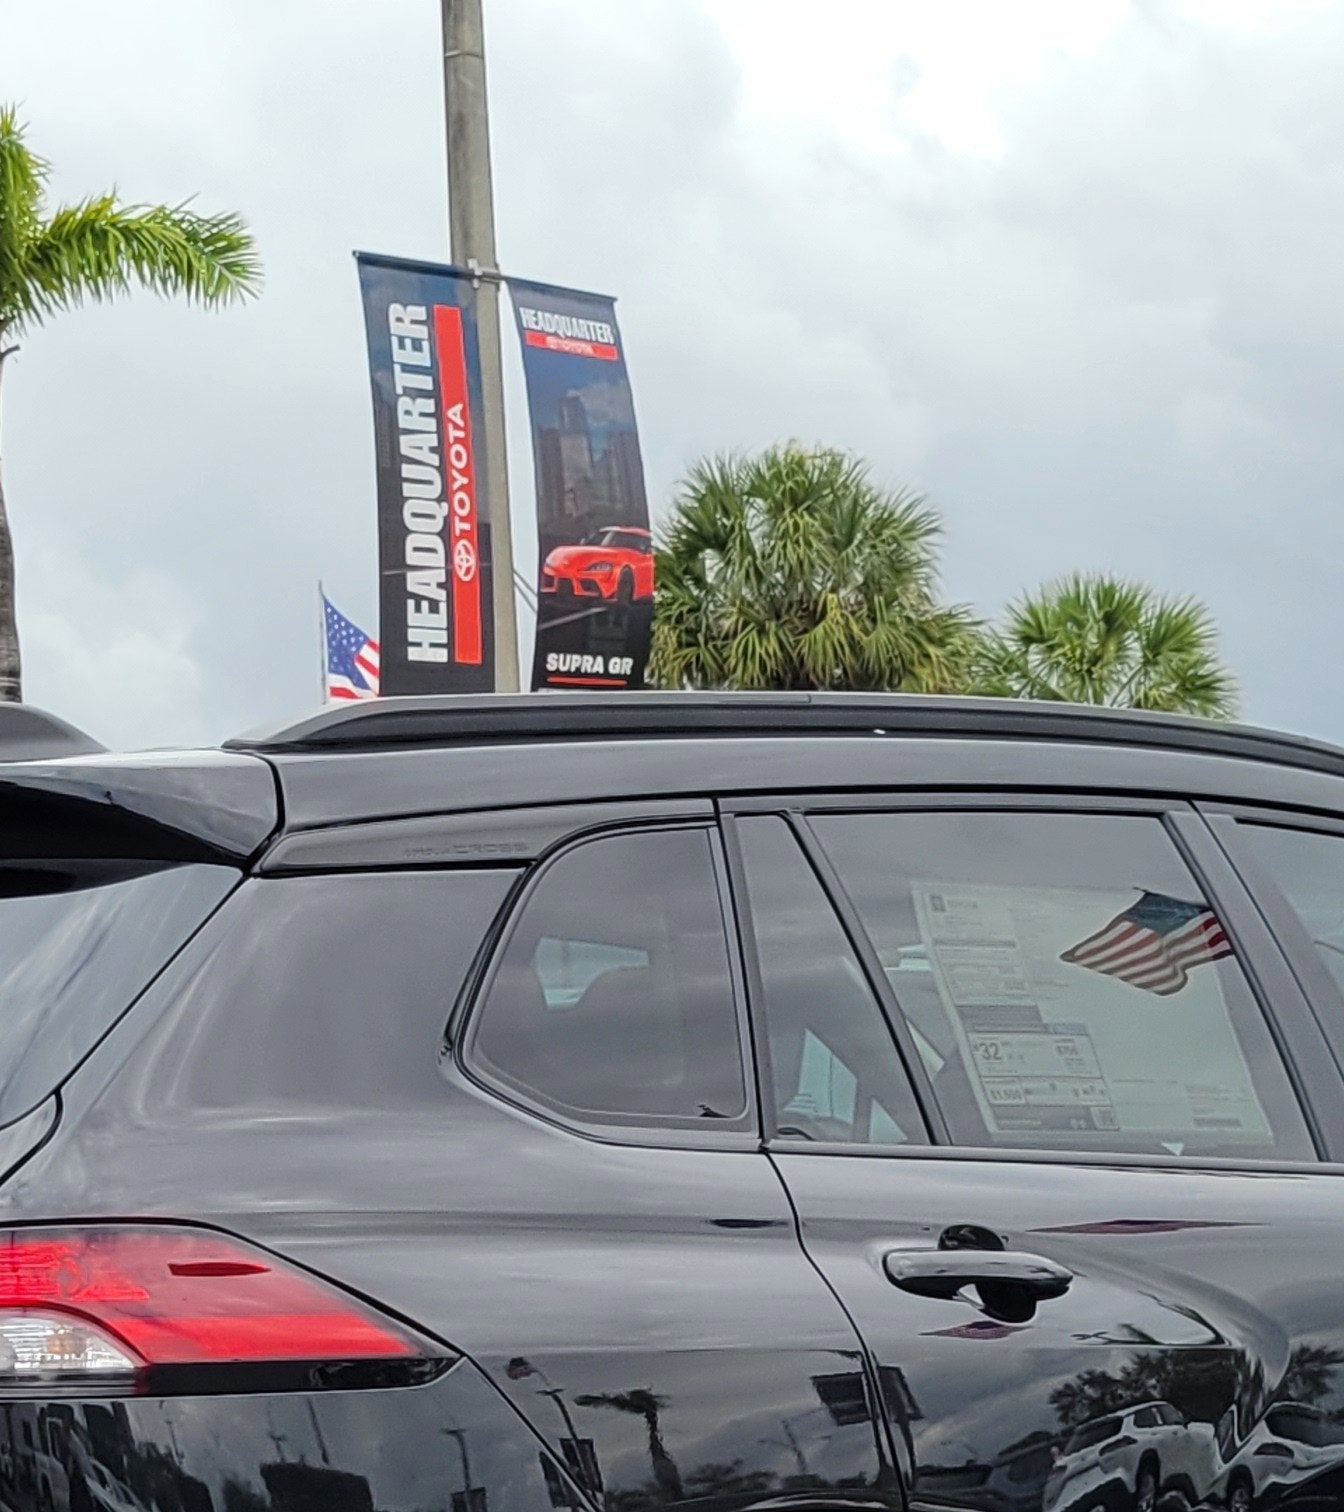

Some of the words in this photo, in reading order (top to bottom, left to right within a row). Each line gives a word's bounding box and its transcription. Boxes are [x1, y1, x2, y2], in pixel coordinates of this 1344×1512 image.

[519, 307, 615, 345] HEADQUARTER
[388, 302, 449, 664] HEADQUARTER
[447, 402, 472, 536] TOYOTA
[546, 653, 604, 674] SUPRA
[608, 657, 633, 675] GR
